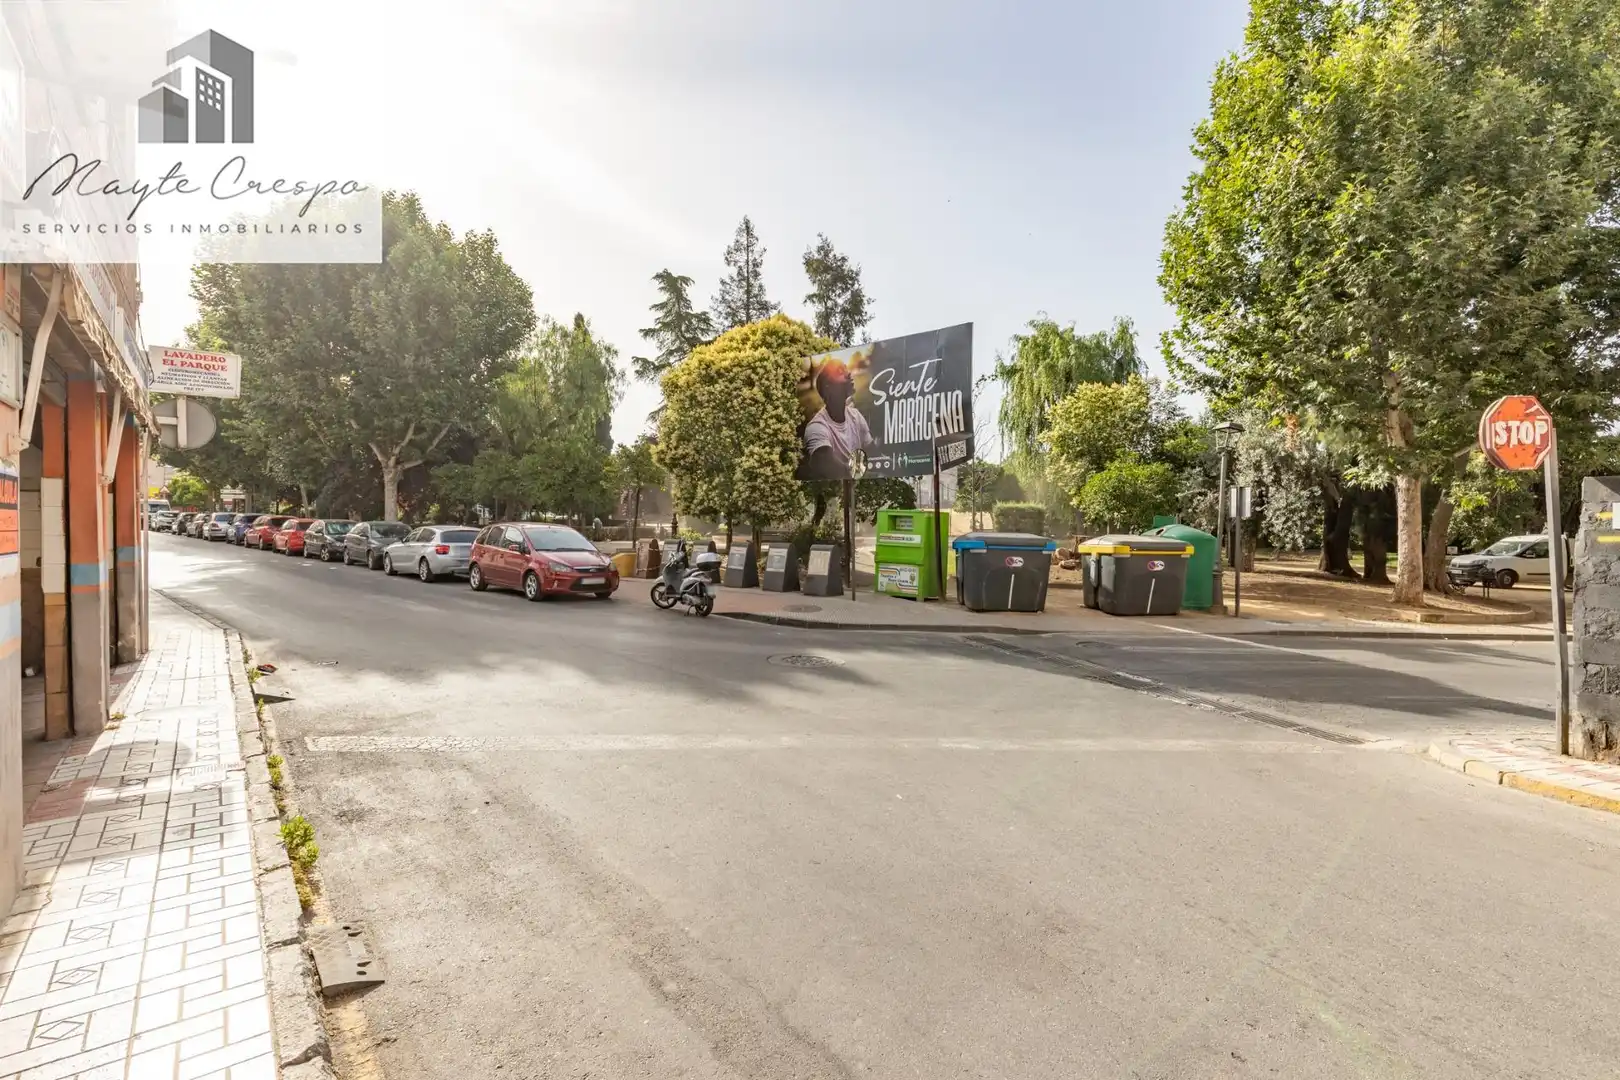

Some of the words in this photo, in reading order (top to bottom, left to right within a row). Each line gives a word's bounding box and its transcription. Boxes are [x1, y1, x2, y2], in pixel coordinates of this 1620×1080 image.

[164, 350, 226, 363] LAVADERO
[180, 360, 228, 372] PARQUE
[869, 358, 942, 405] Siente
[884, 390, 964, 444] MARACENA
[1494, 420, 1548, 448] STOP
